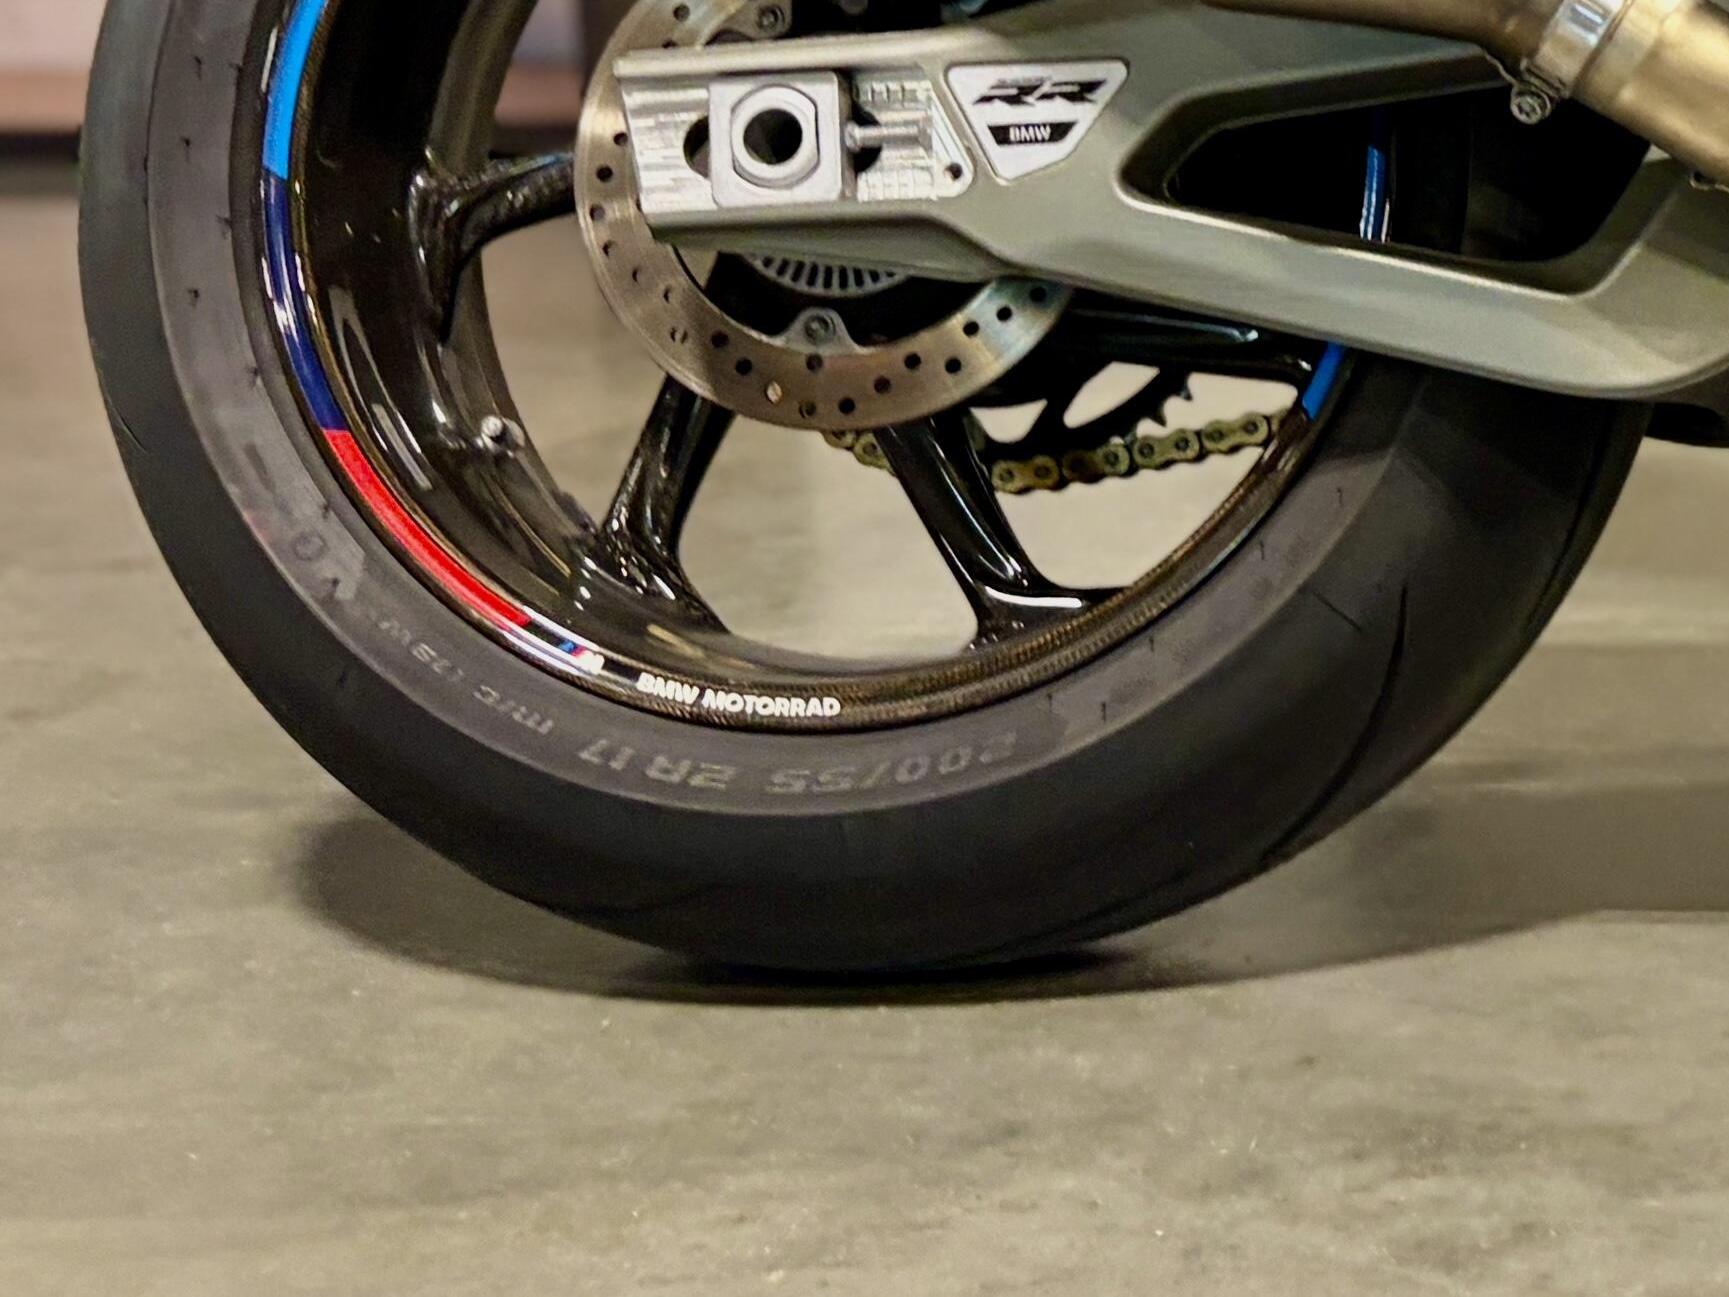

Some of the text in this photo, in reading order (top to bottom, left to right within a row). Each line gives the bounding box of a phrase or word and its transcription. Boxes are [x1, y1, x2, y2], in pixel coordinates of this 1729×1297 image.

[1008, 124, 1053, 143] BMW
[634, 671, 842, 719] BMW MOTORRAD
